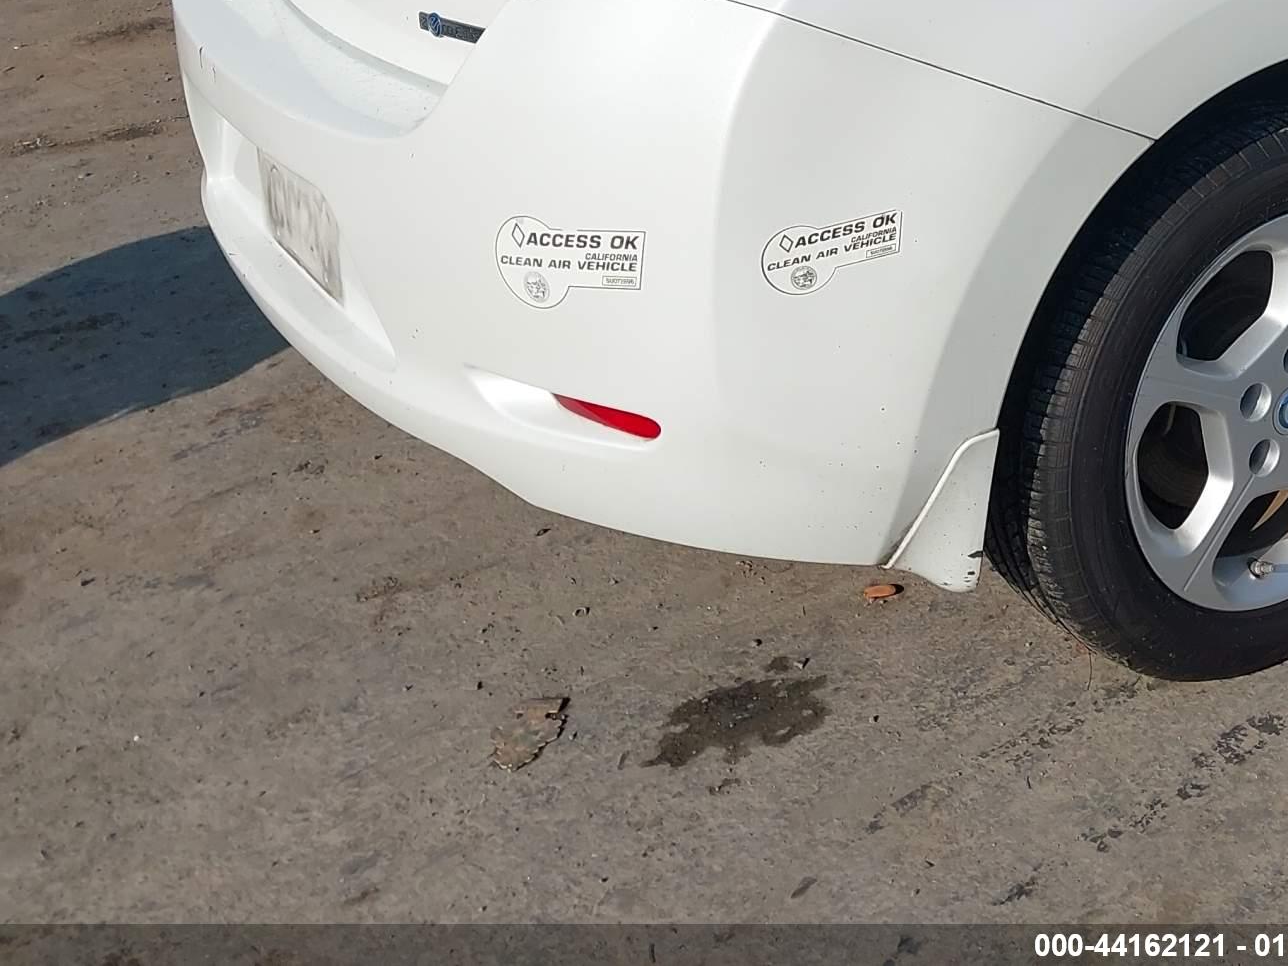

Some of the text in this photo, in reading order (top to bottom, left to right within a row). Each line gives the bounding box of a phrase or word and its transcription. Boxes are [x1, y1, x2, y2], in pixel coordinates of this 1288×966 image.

[794, 213, 897, 248] ACCESS OK
[851, 226, 897, 243] CALIFORNIA
[526, 232, 640, 250] ACCESS OK
[585, 253, 638, 262] CALIFORNIA
[767, 253, 811, 271] CLEAN
[816, 247, 838, 260] AIR
[844, 233, 897, 253] VEHICLE
[500, 255, 637, 272] CLEAN AIR VEHICLE
